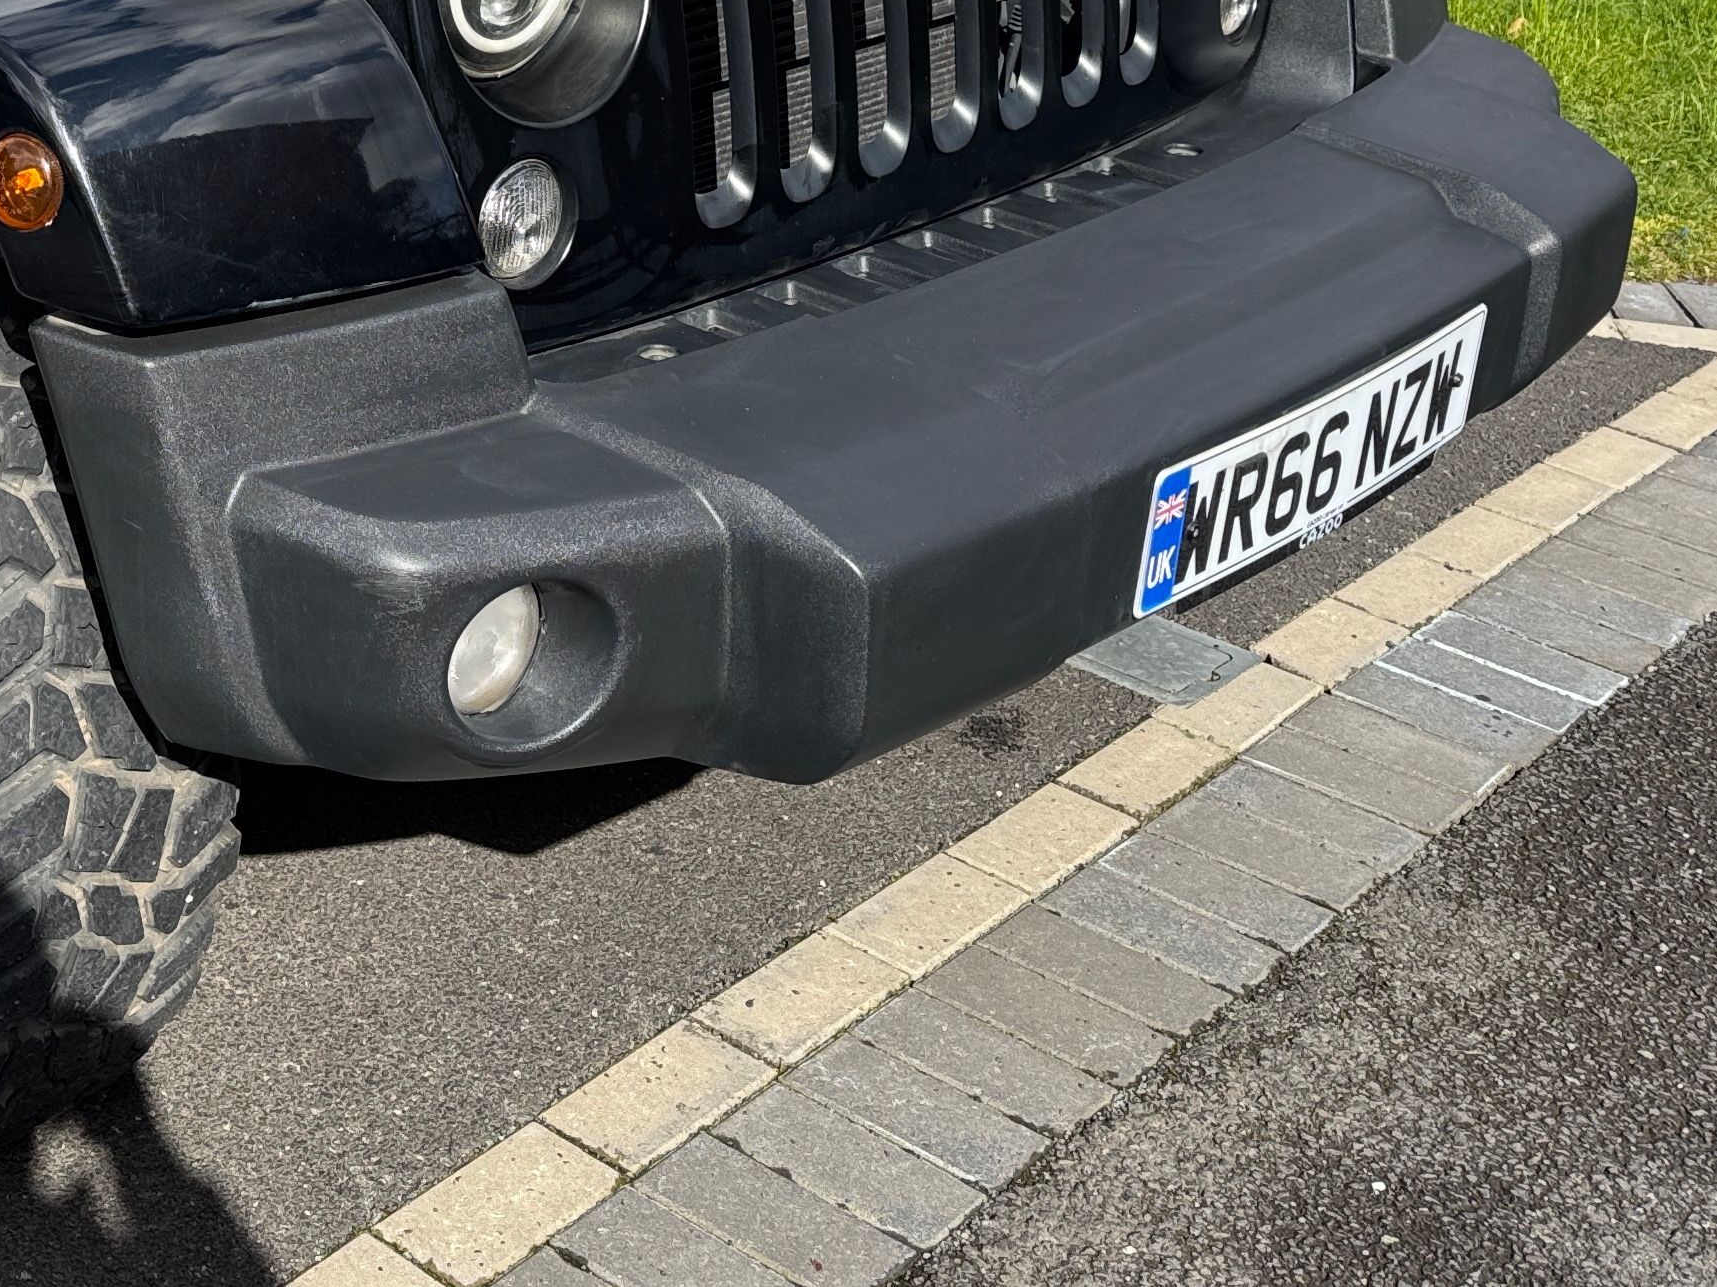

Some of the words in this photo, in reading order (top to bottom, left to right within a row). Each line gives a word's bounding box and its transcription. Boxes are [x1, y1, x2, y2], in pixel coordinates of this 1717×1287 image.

[1173, 410, 1350, 587] WR66
[1354, 339, 1464, 490] NZW
[1299, 512, 1343, 550] CAZOO
[1146, 545, 1177, 589] UK
